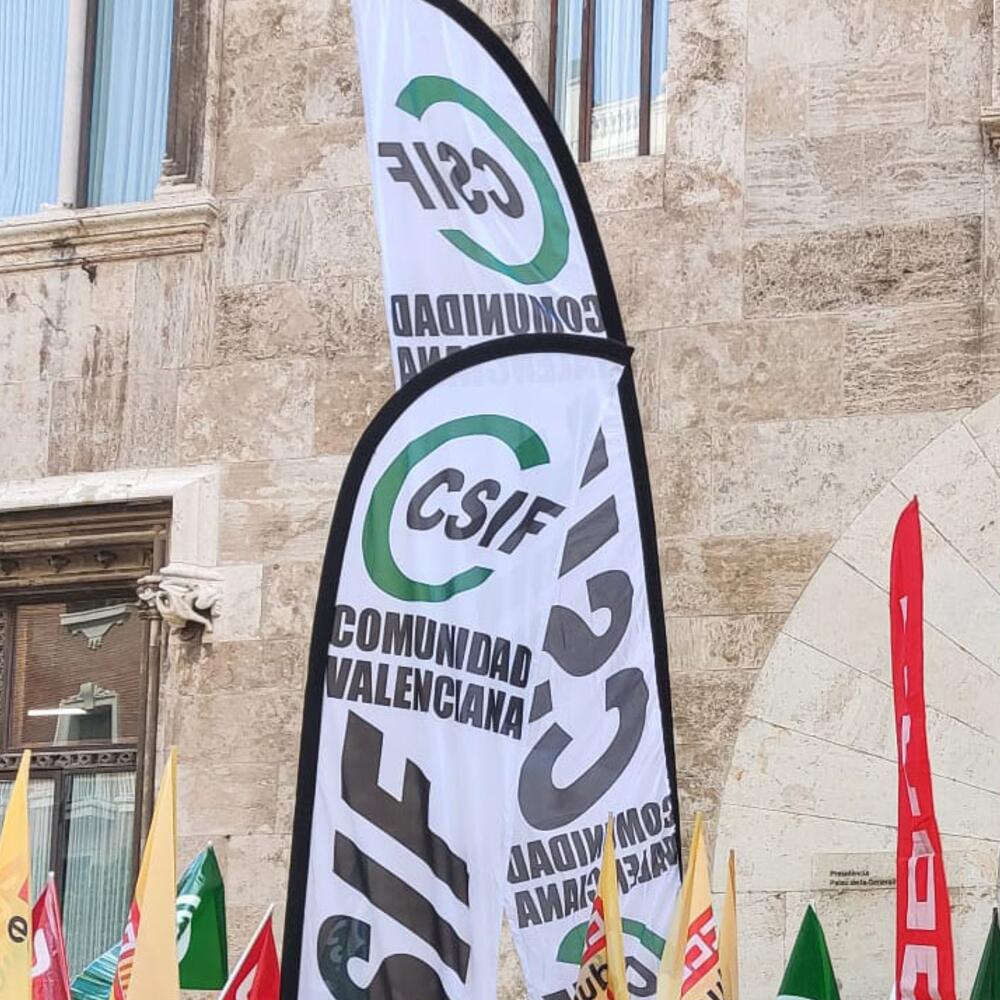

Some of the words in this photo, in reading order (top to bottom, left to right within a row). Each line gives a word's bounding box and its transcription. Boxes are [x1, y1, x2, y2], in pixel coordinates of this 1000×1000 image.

[406, 467, 566, 555] CSIF
[329, 604, 532, 689] COMUNIDAD
[326, 656, 525, 740] VALENCIANA
